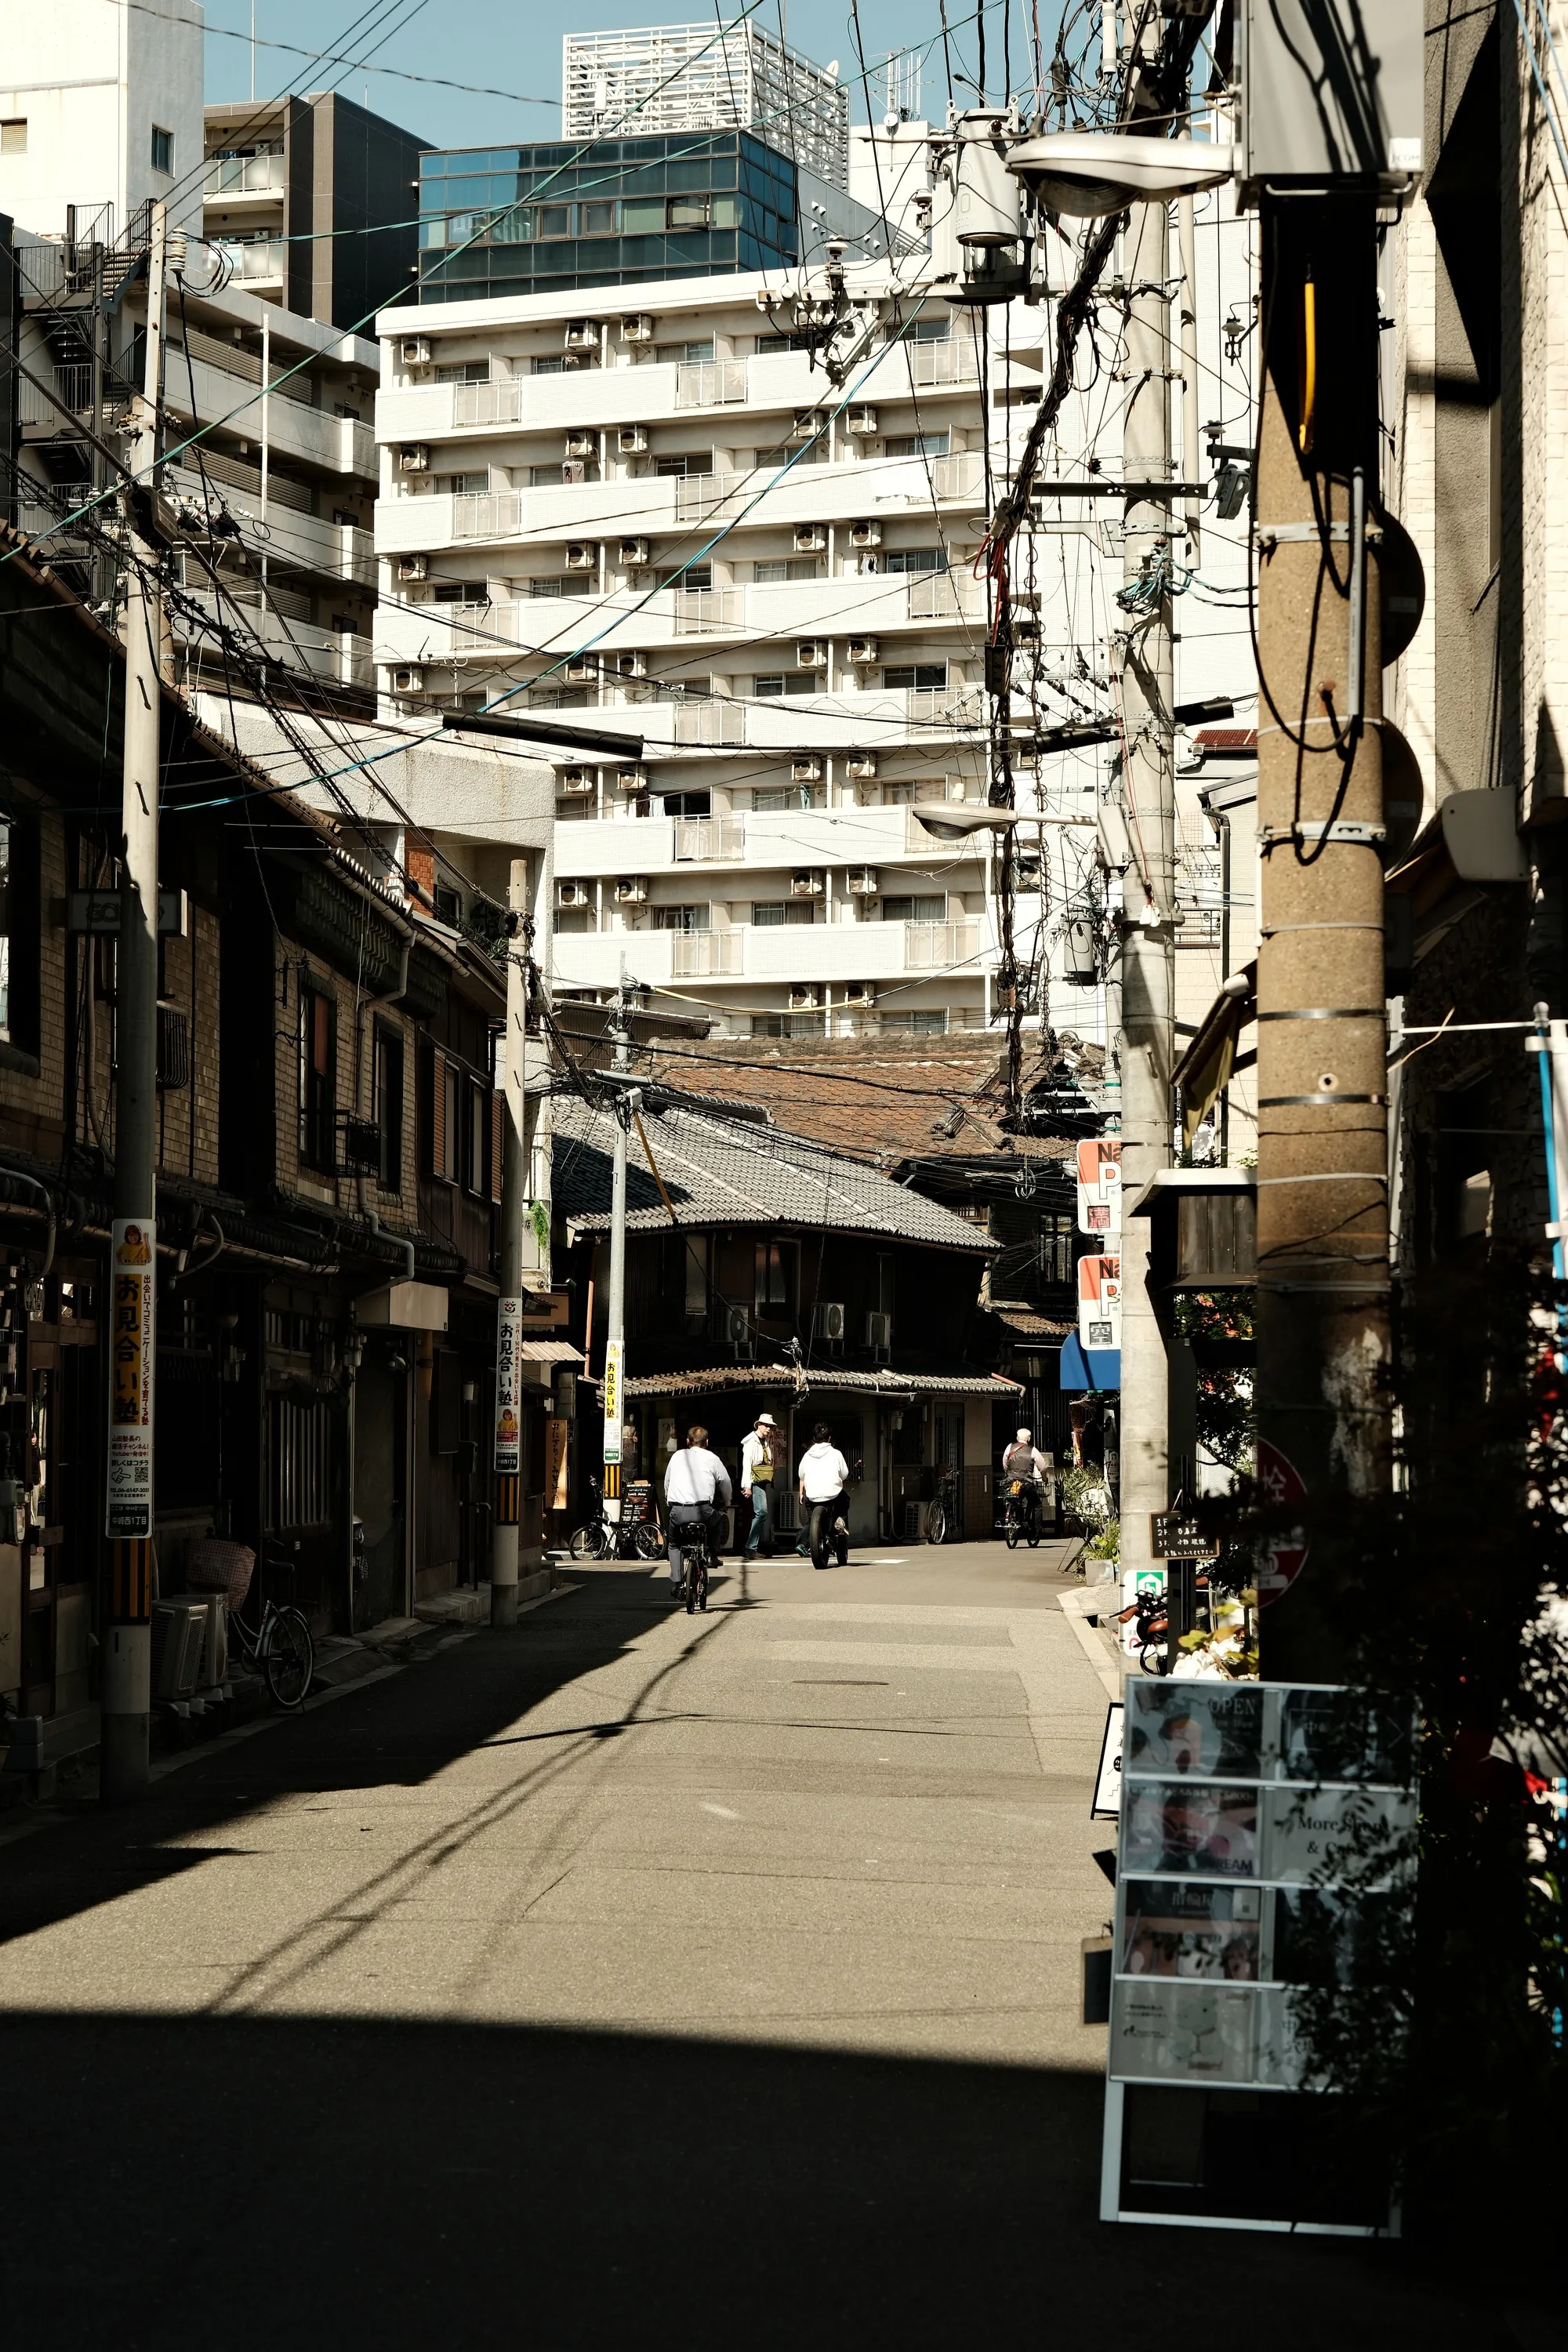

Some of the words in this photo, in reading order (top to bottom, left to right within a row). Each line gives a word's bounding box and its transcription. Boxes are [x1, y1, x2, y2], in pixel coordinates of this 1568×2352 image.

[1090, 1323, 1112, 1345] 空
[114, 1276, 140, 1423] お見合い塾
[498, 1323, 514, 1406] お見合い塾
[607, 1362, 615, 1418] お見合い塾
[1209, 1697, 1256, 1715] OPEN
[1298, 1816, 1339, 1831] More
[1307, 1841, 1318, 1854] &
